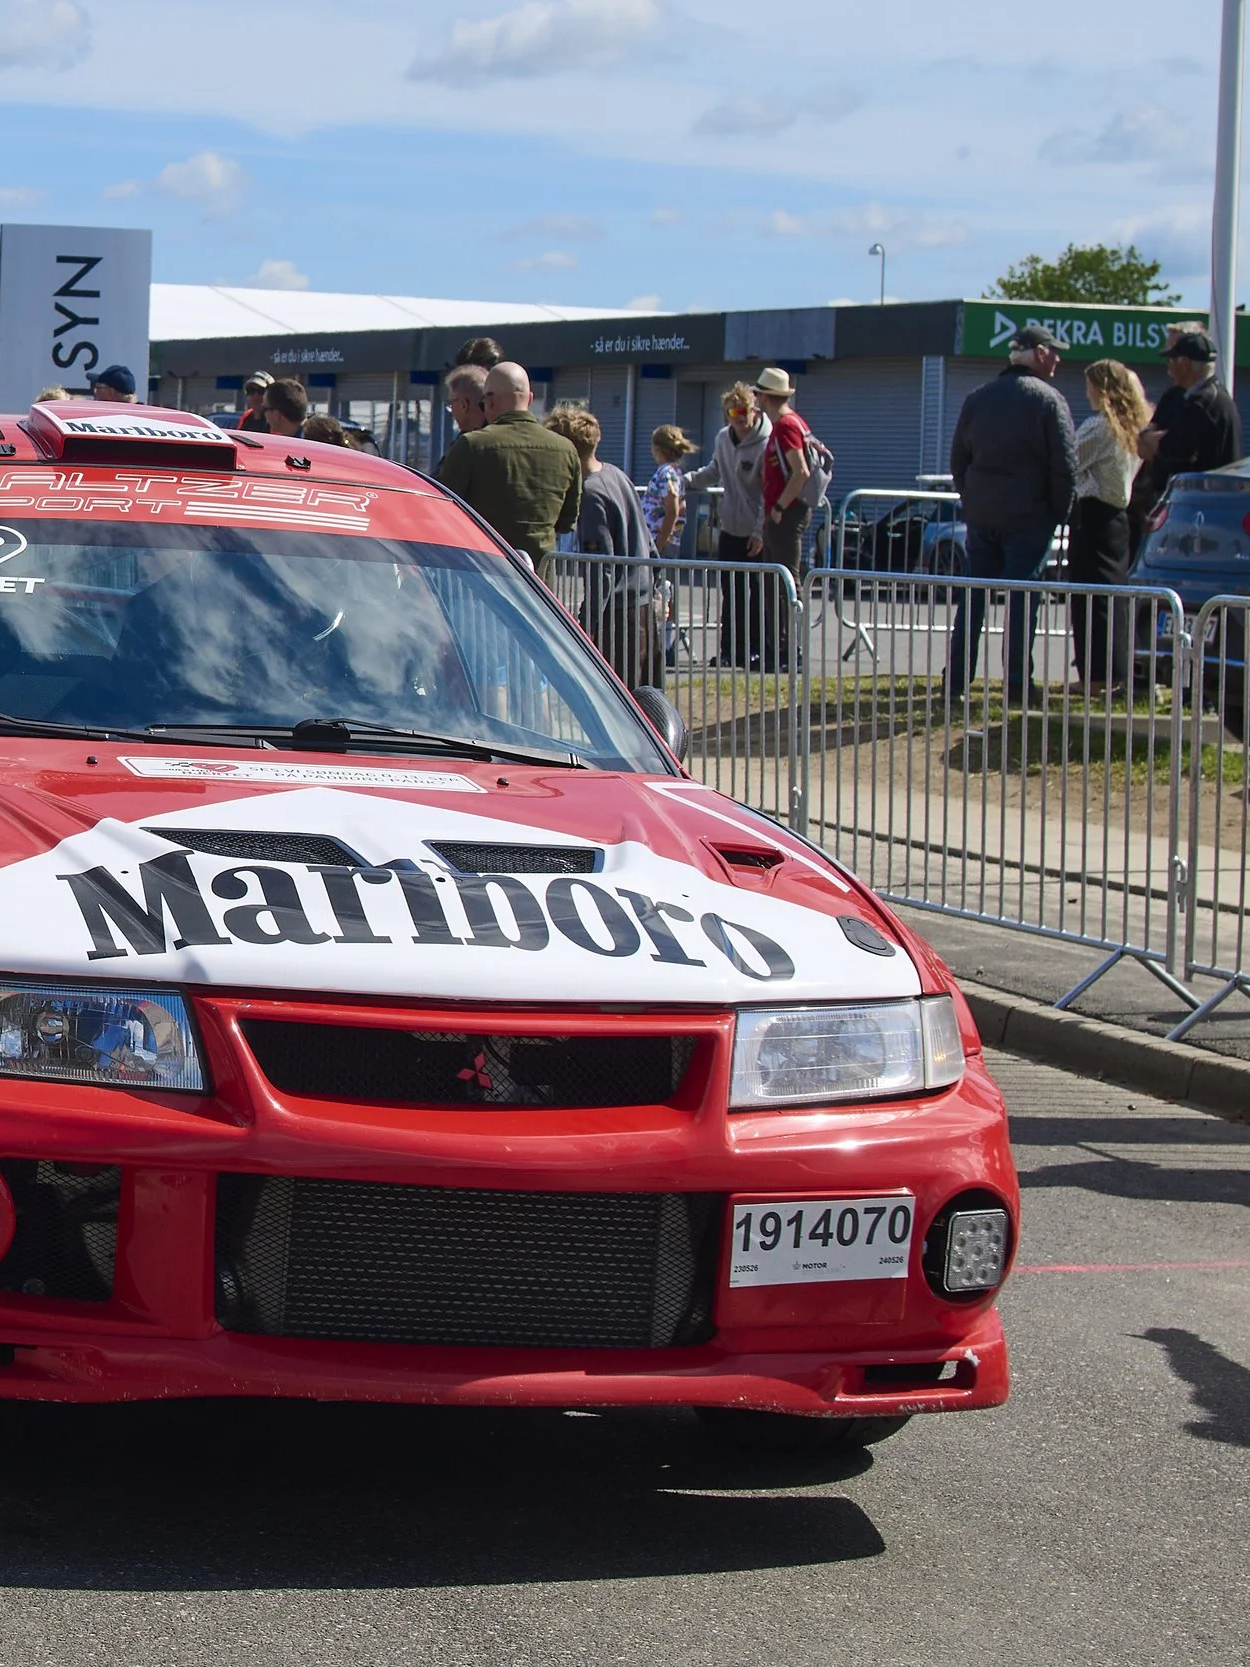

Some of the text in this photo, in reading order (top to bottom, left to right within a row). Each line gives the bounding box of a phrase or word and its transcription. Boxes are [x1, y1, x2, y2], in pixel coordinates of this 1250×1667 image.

[595, 337, 603, 353] så
[605, 340, 613, 352] er
[615, 336, 625, 352] du
[631, 334, 650, 351] sikre
[64, 421, 223, 441] Marlboro
[56, 850, 796, 982] Marlboro
[736, 1205, 911, 1252] 1914070
[879, 1255, 904, 1265] 240526
